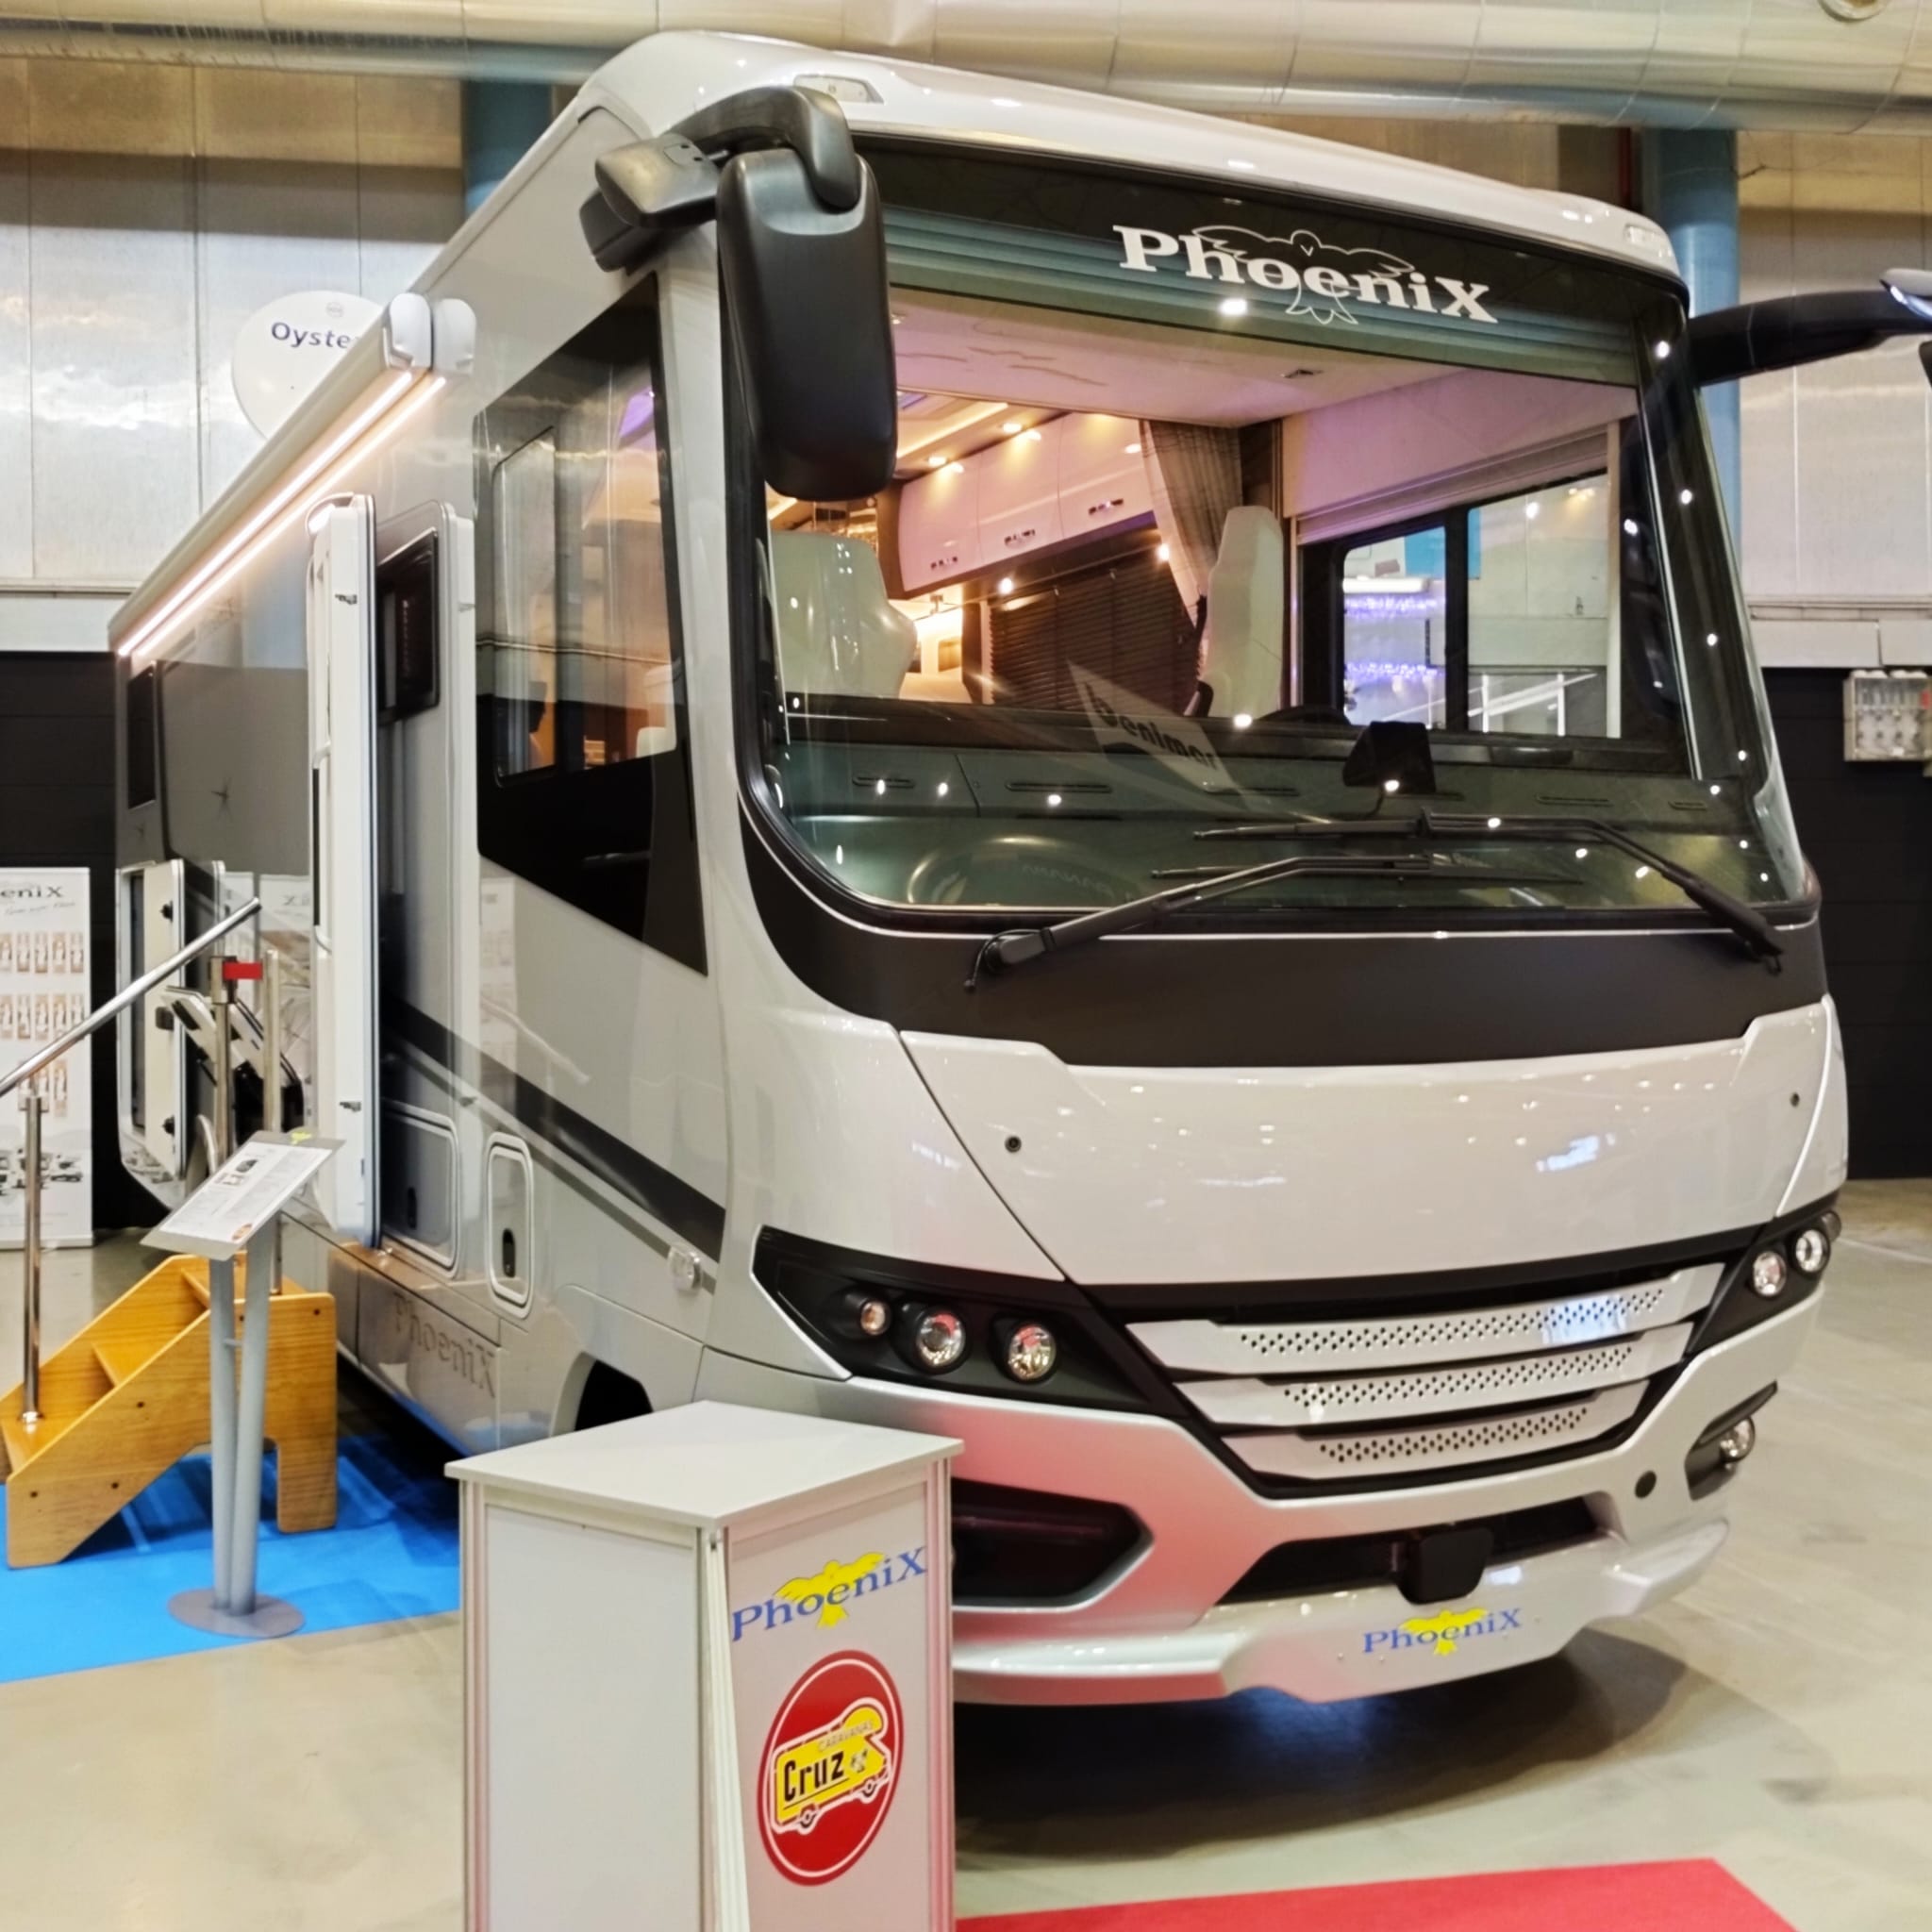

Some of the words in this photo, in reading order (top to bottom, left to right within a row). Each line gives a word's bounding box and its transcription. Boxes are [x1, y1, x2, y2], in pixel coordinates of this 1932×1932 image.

[1113, 225, 1498, 324] PhoeniX
[270, 322, 358, 348] Oyste
[392, 1291, 496, 1399] PhoeniX
[731, 1546, 927, 1642] PhoeniX
[1362, 1607, 1521, 1653] PhoeniX
[784, 1751, 844, 1802] Cruz
